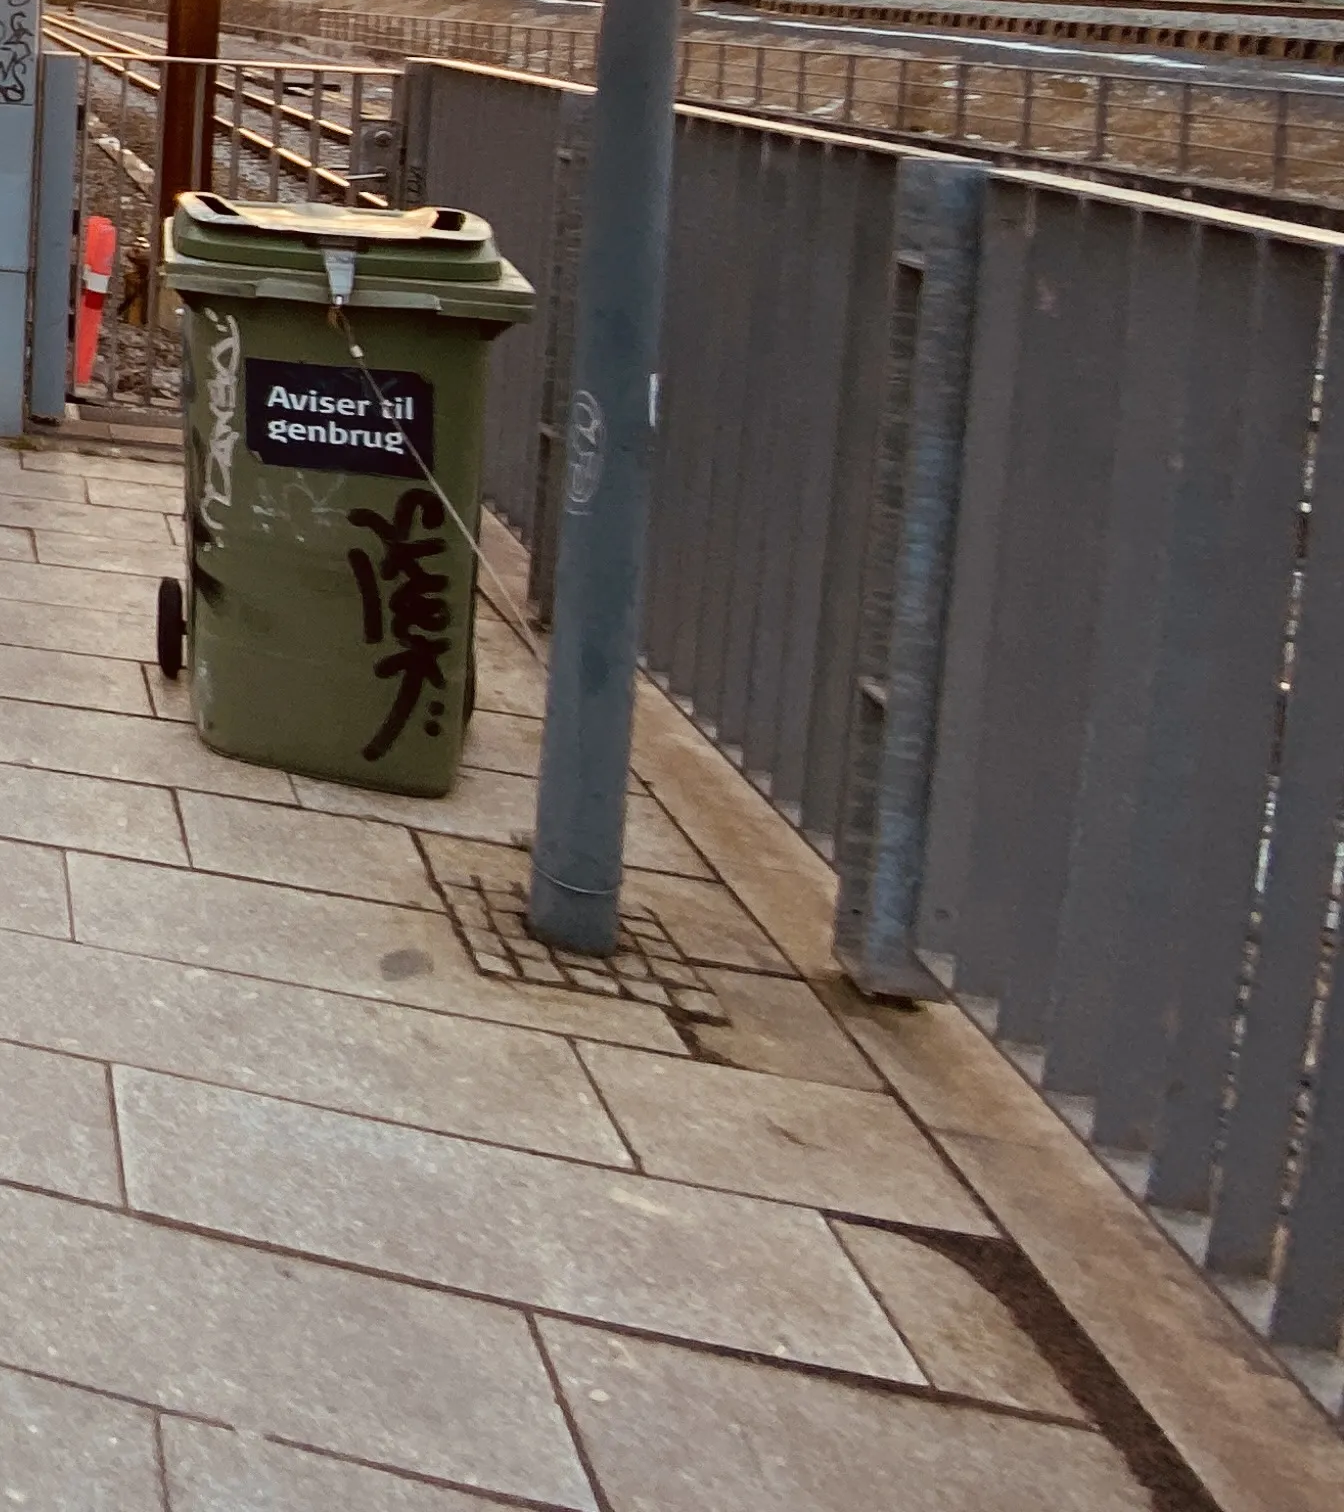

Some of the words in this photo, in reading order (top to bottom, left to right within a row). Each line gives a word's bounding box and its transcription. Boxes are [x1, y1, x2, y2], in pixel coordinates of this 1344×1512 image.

[267, 385, 371, 417] Aviser
[379, 396, 414, 420] til
[267, 419, 405, 455] genbrug
